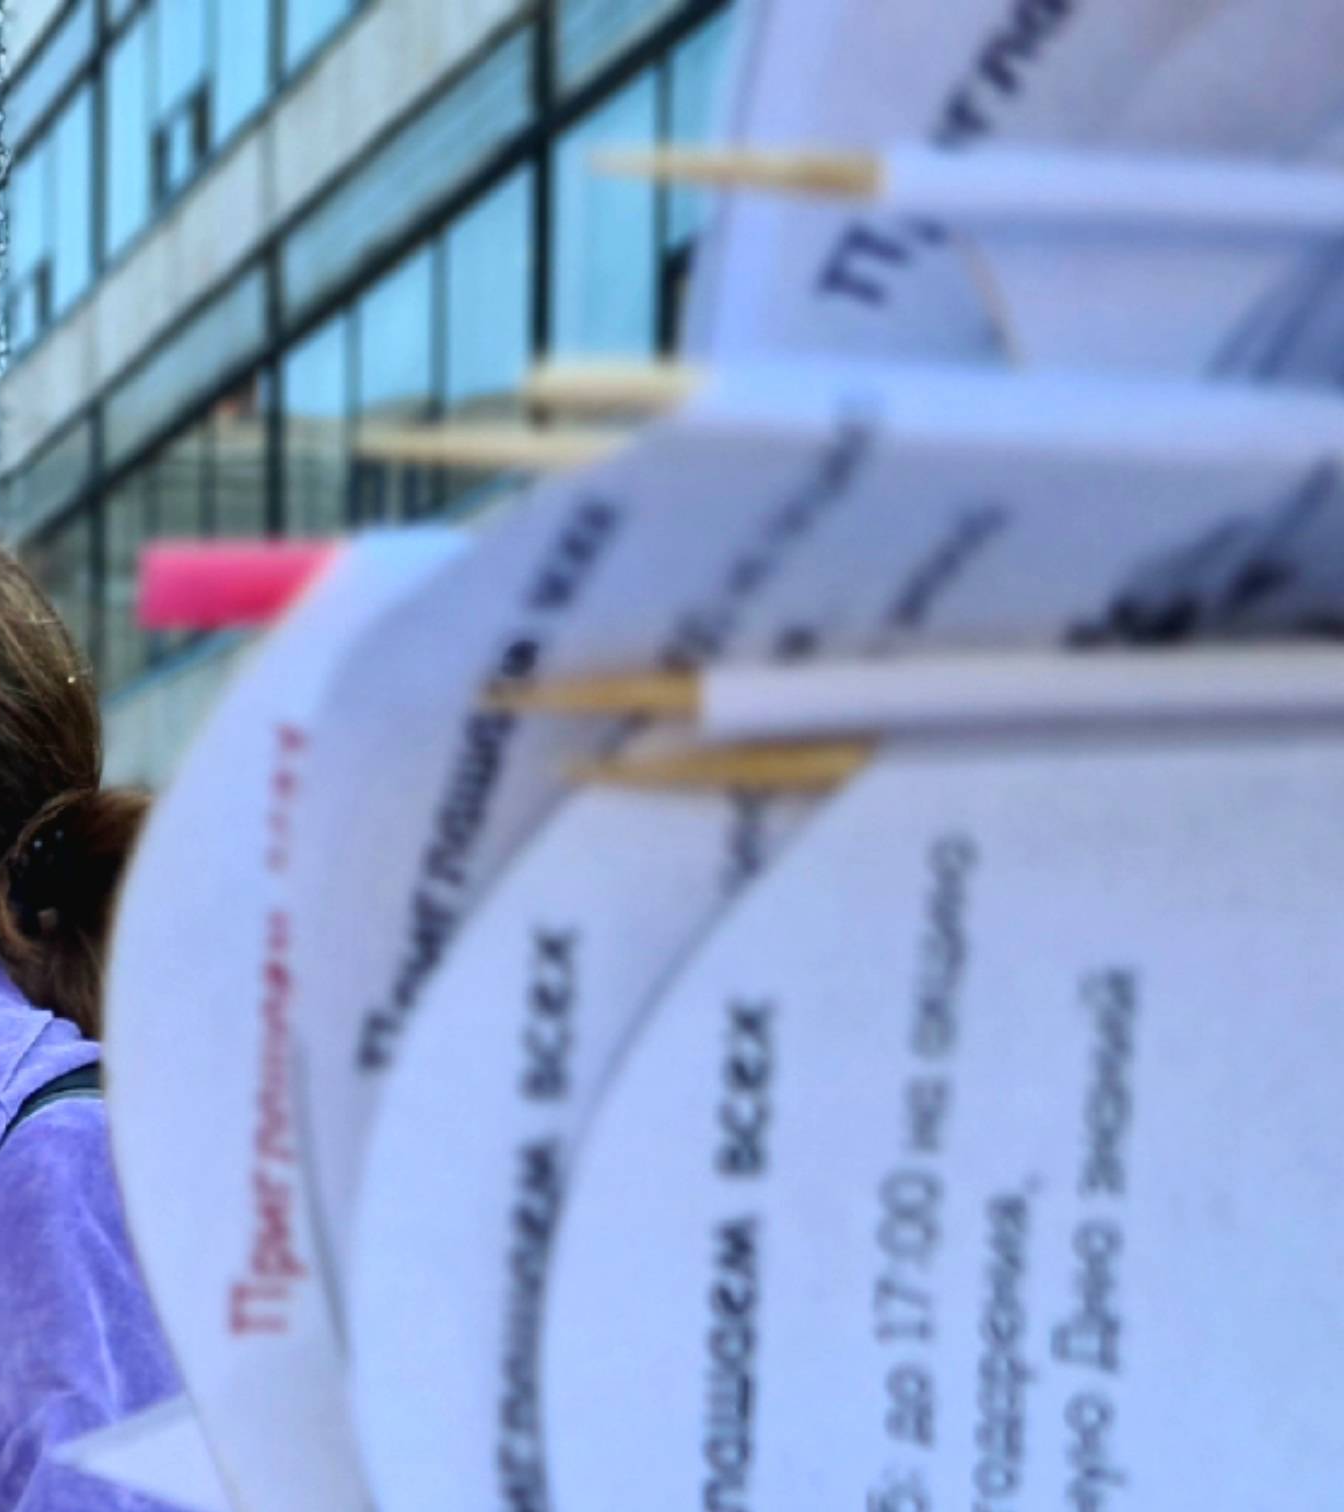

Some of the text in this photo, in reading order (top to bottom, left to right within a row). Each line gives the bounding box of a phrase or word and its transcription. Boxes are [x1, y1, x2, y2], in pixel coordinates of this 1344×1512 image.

[520, 926, 582, 1101] всех
[715, 999, 777, 1181] всех
[904, 1075, 951, 1155] на
[873, 1168, 945, 1345] 17:00
[1050, 1218, 1123, 1376] Дню
[883, 1360, 935, 1449] до
